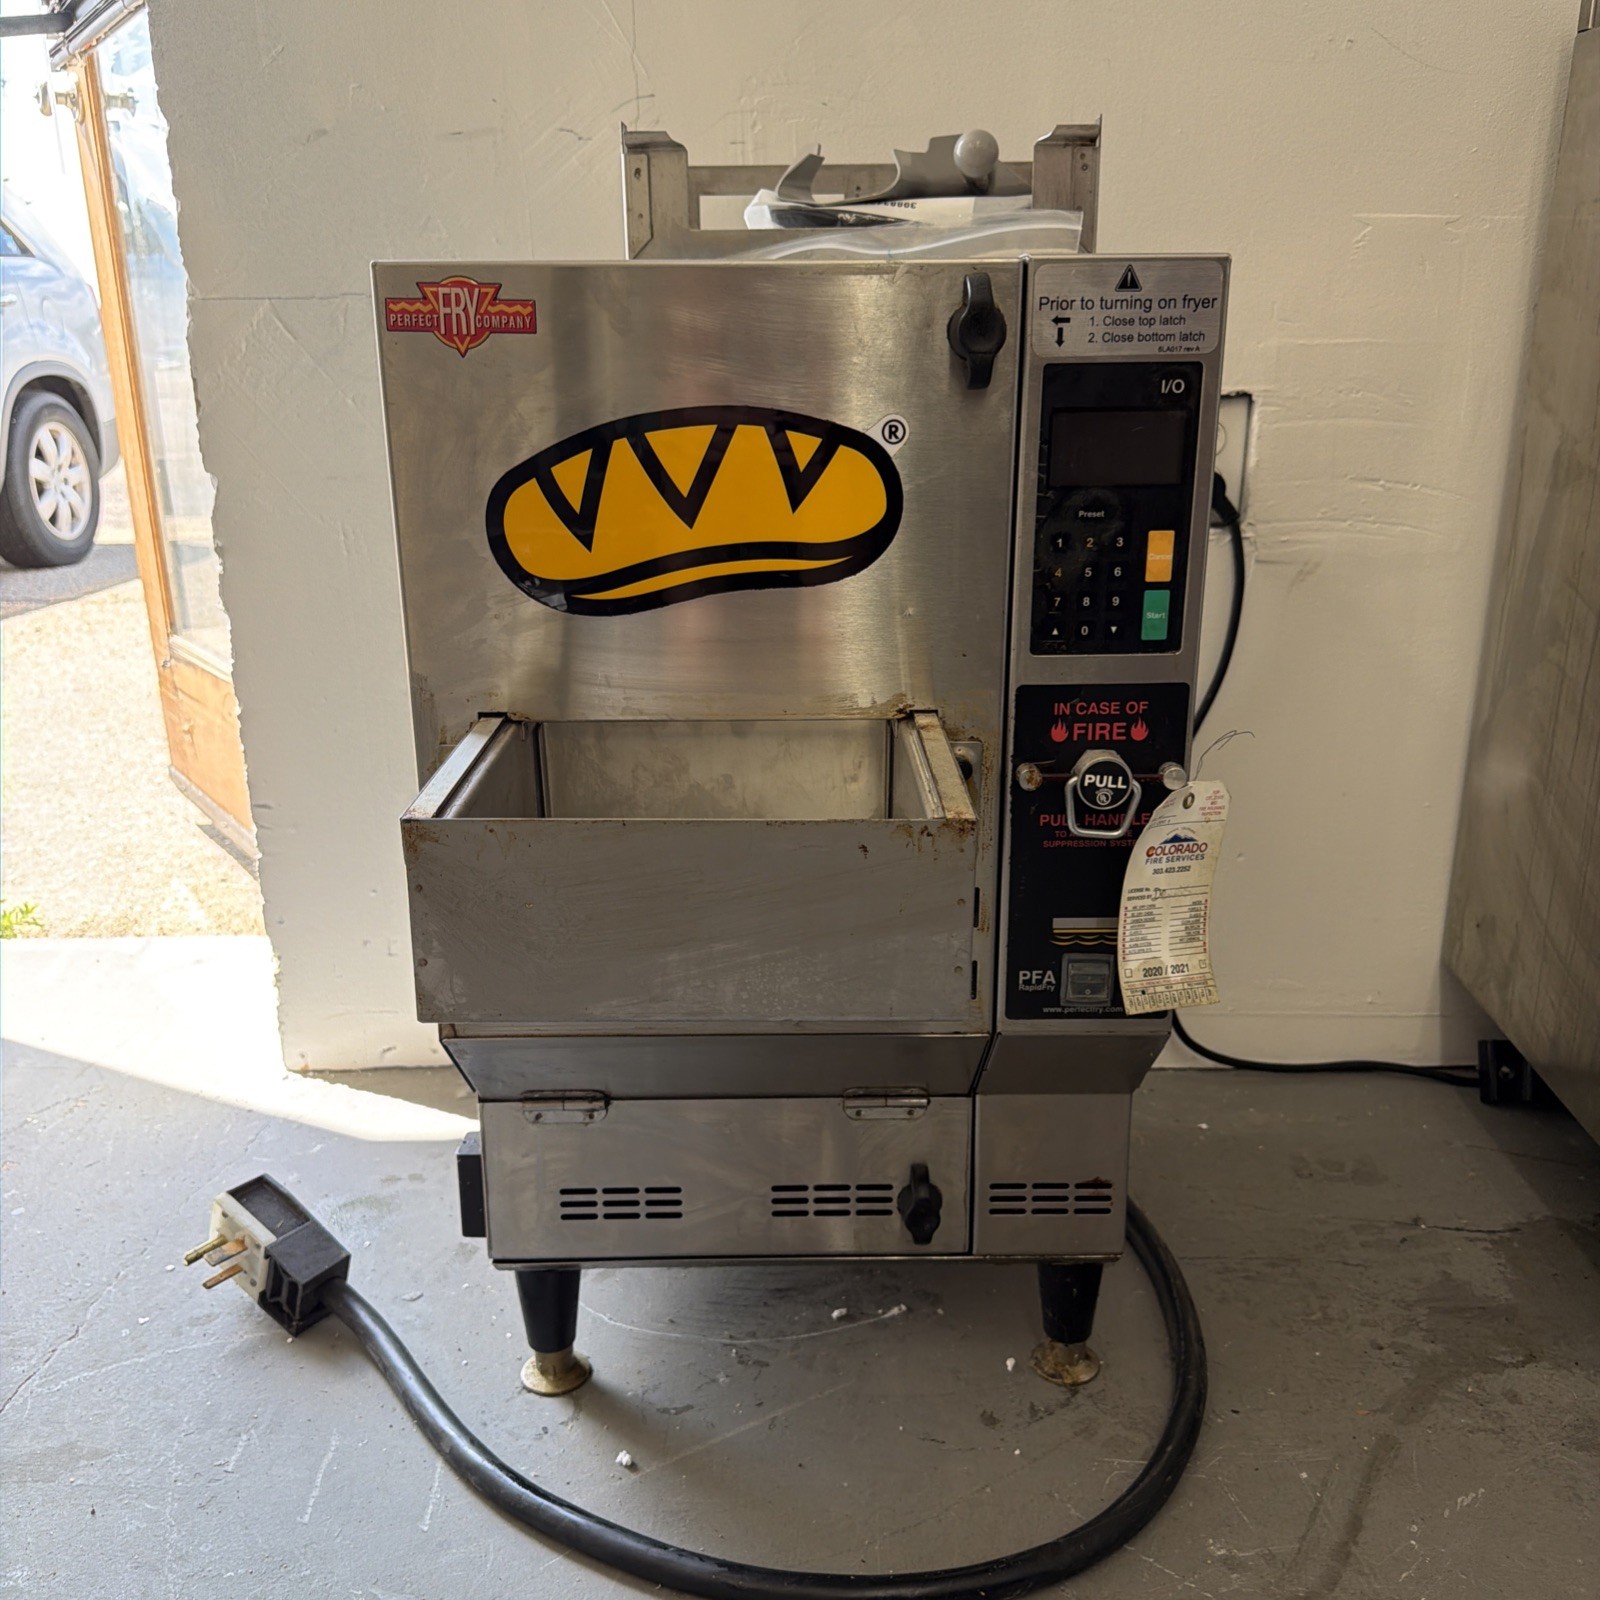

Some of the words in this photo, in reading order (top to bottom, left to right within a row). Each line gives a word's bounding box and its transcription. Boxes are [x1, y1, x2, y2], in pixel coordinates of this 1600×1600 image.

[1038, 296, 1076, 311] Prior
[1080, 297, 1095, 310] to
[1100, 296, 1151, 312] turning
[1158, 297, 1177, 309] on
[1182, 294, 1217, 312] fryer
[390, 313, 439, 327] PERFECT
[438, 287, 479, 335] FRY
[476, 315, 532, 328] COMPANY
[1089, 317, 1099, 327] 1.
[1102, 316, 1135, 327] Close
[1138, 316, 1156, 328] top
[1159, 315, 1186, 326] latch
[1087, 334, 1098, 344] 2.
[1101, 332, 1134, 343] Close
[1137, 331, 1176, 342] bottom
[1179, 331, 1206, 342] latch
[1160, 379, 1185, 394] I/O
[1078, 510, 1105, 518] Preset
[1056, 538, 1063, 548] 1
[1086, 537, 1094, 547] 2
[1116, 537, 1124, 547] 3
[1054, 568, 1062, 578] 4
[1084, 567, 1092, 577] 5
[1114, 567, 1122, 577] 6
[1054, 597, 1061, 607] 7
[1082, 597, 1090, 607] 8
[1112, 597, 1120, 606] 9
[1081, 626, 1089, 636] 0
[1054, 702, 1070, 715] IN
[1076, 702, 1120, 715] CASE
[1125, 701, 1149, 714] OF
[1072, 722, 1126, 741] FIRE
[1084, 774, 1127, 789] PULL
[1039, 814, 1080, 827] PUL
[1085, 812, 1151, 827] HANLE
[1055, 830, 1067, 838] TO
[1043, 840, 1106, 848] SUPPRESSION
[1110, 839, 1136, 847] SYST
[1146, 842, 1208, 858] COLORADO
[1145, 856, 1164, 865] FIRE
[1165, 853, 1205, 863] SERVICES
[1142, 966, 1163, 978] 2020
[1170, 963, 1190, 975] 2021
[1018, 970, 1056, 985] PFA
[1018, 983, 1055, 992] RapidFry
